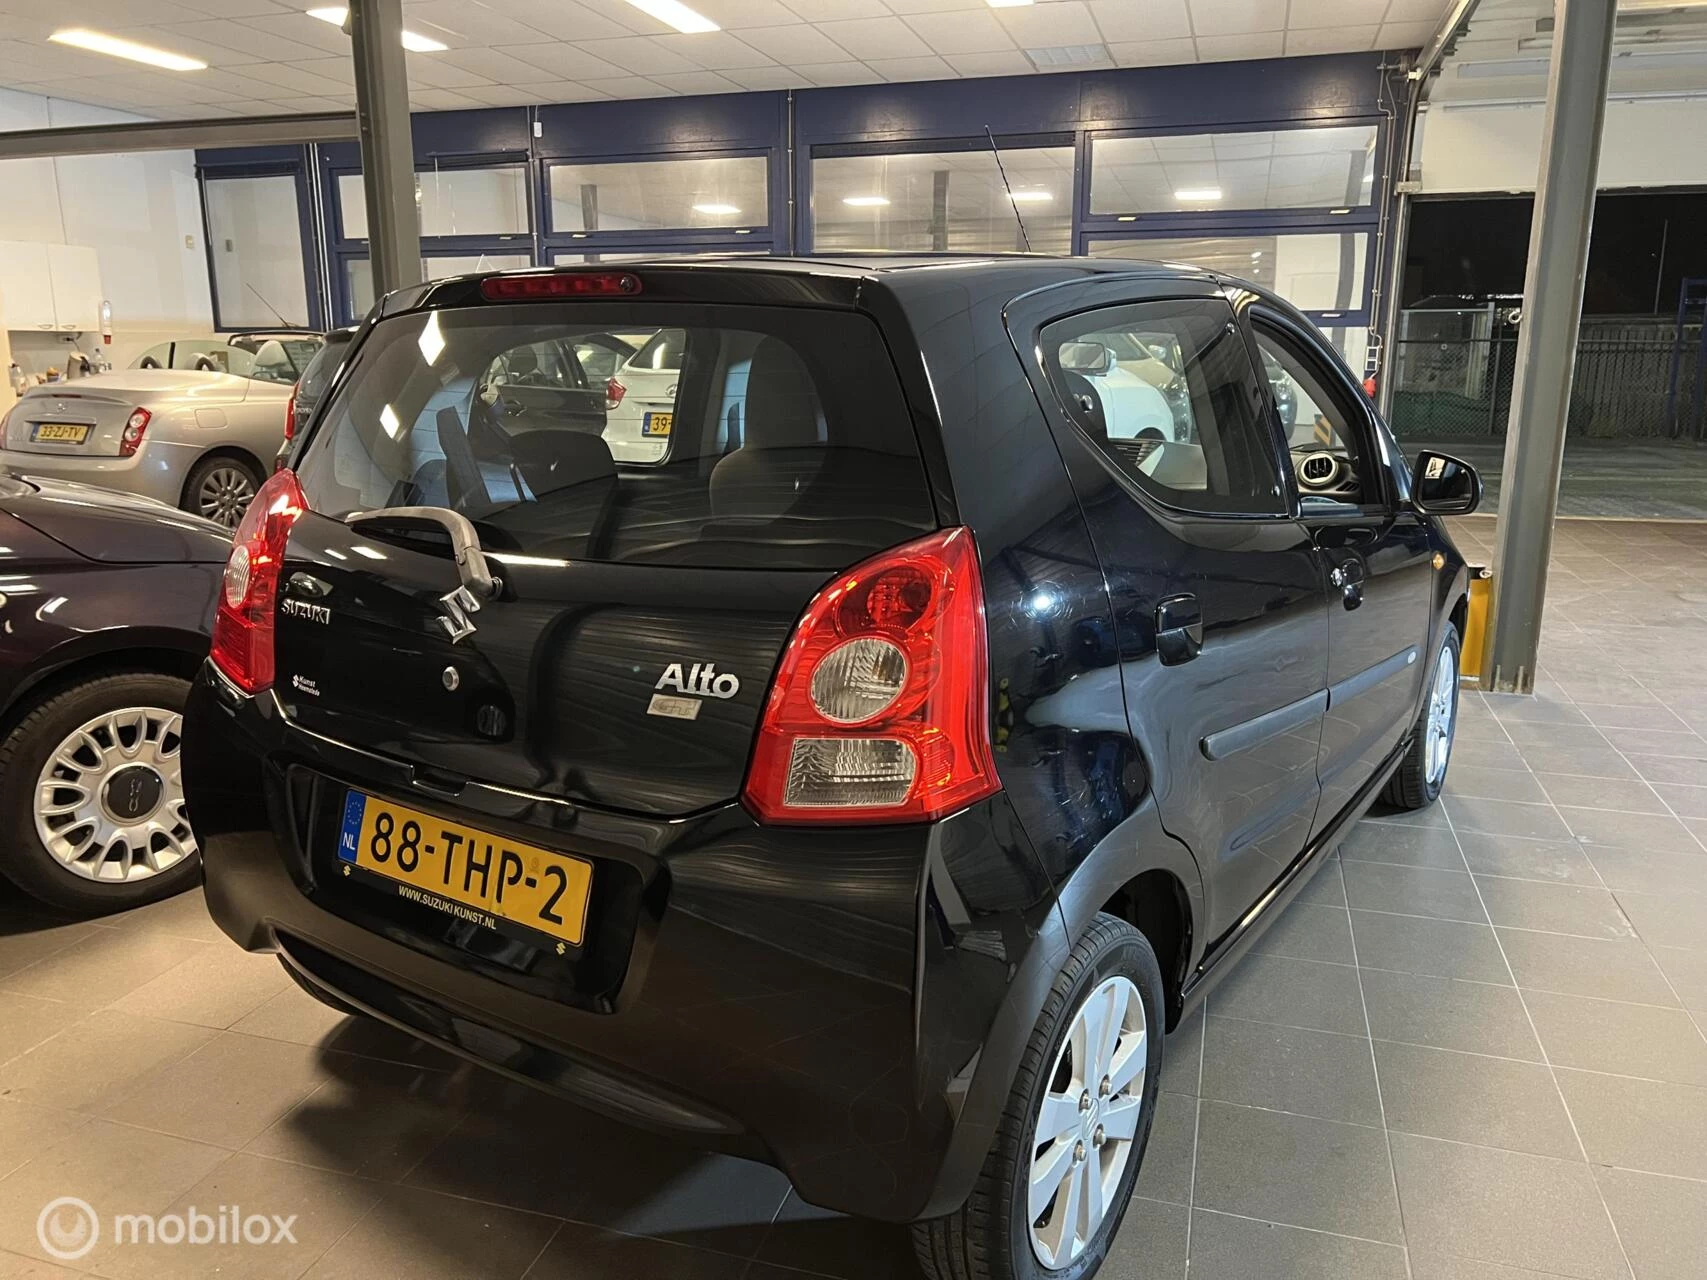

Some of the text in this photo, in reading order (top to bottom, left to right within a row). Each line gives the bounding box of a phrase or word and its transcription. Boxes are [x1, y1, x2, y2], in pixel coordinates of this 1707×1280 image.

[281, 598, 330, 624] SUZUKI
[654, 663, 740, 699] Alto
[342, 831, 356, 851] NL
[370, 811, 569, 926] 88-THP-2
